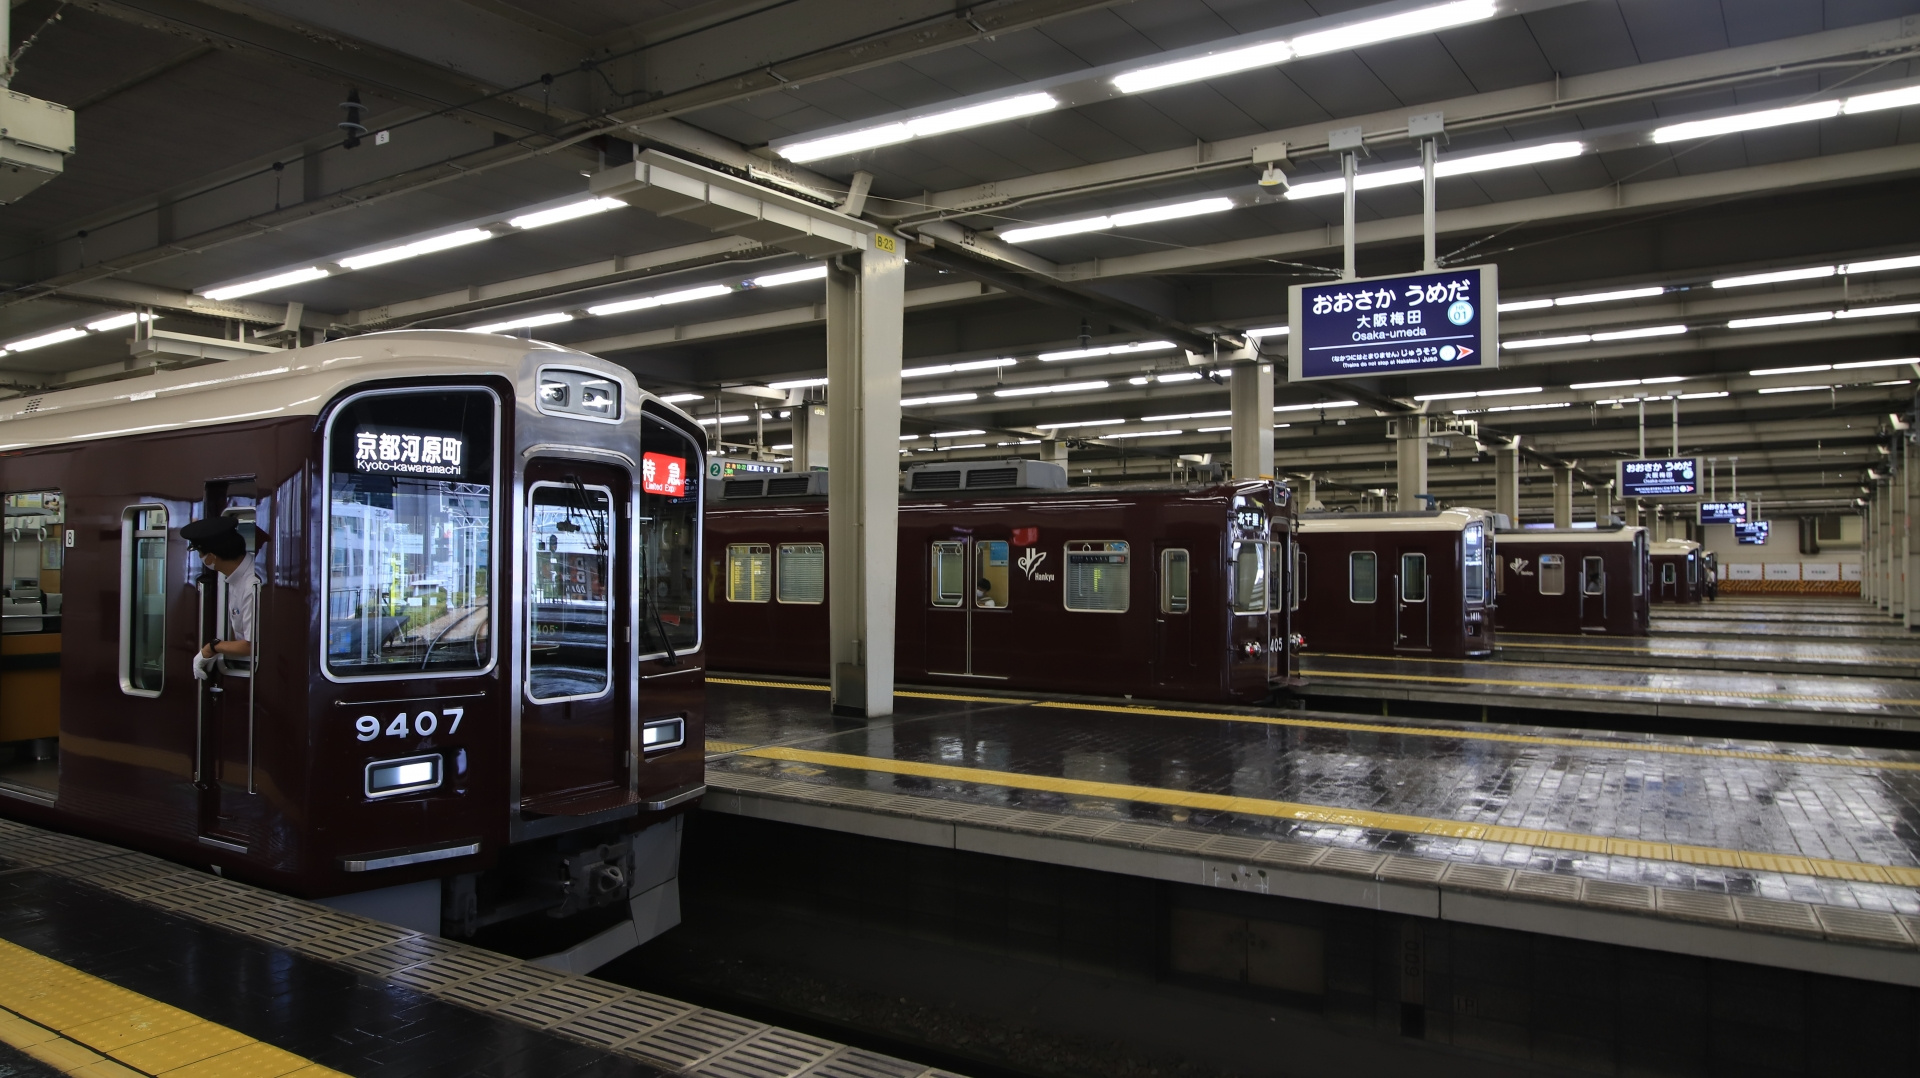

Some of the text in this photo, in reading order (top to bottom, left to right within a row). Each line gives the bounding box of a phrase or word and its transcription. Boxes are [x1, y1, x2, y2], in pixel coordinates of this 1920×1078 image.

[1312, 279, 1471, 315] おおさか うめだ
[1356, 309, 1422, 329] 大阪梅田
[1453, 311, 1467, 321] 01
[1352, 326, 1427, 342] Osaka-umeda
[356, 431, 462, 465] 京都河原町
[357, 459, 461, 475] Kyoto-kawaramachi
[643, 458, 680, 486] 特急
[712, 465, 719, 475] 2
[1626, 461, 1693, 473] おおさか うめだ
[645, 481, 663, 491] Limited
[1237, 511, 1260, 527] 北千里
[68, 532, 72, 545] 8
[1034, 572, 1055, 582] Hankyu
[1270, 638, 1283, 652] 405
[355, 706, 464, 742] 9407
